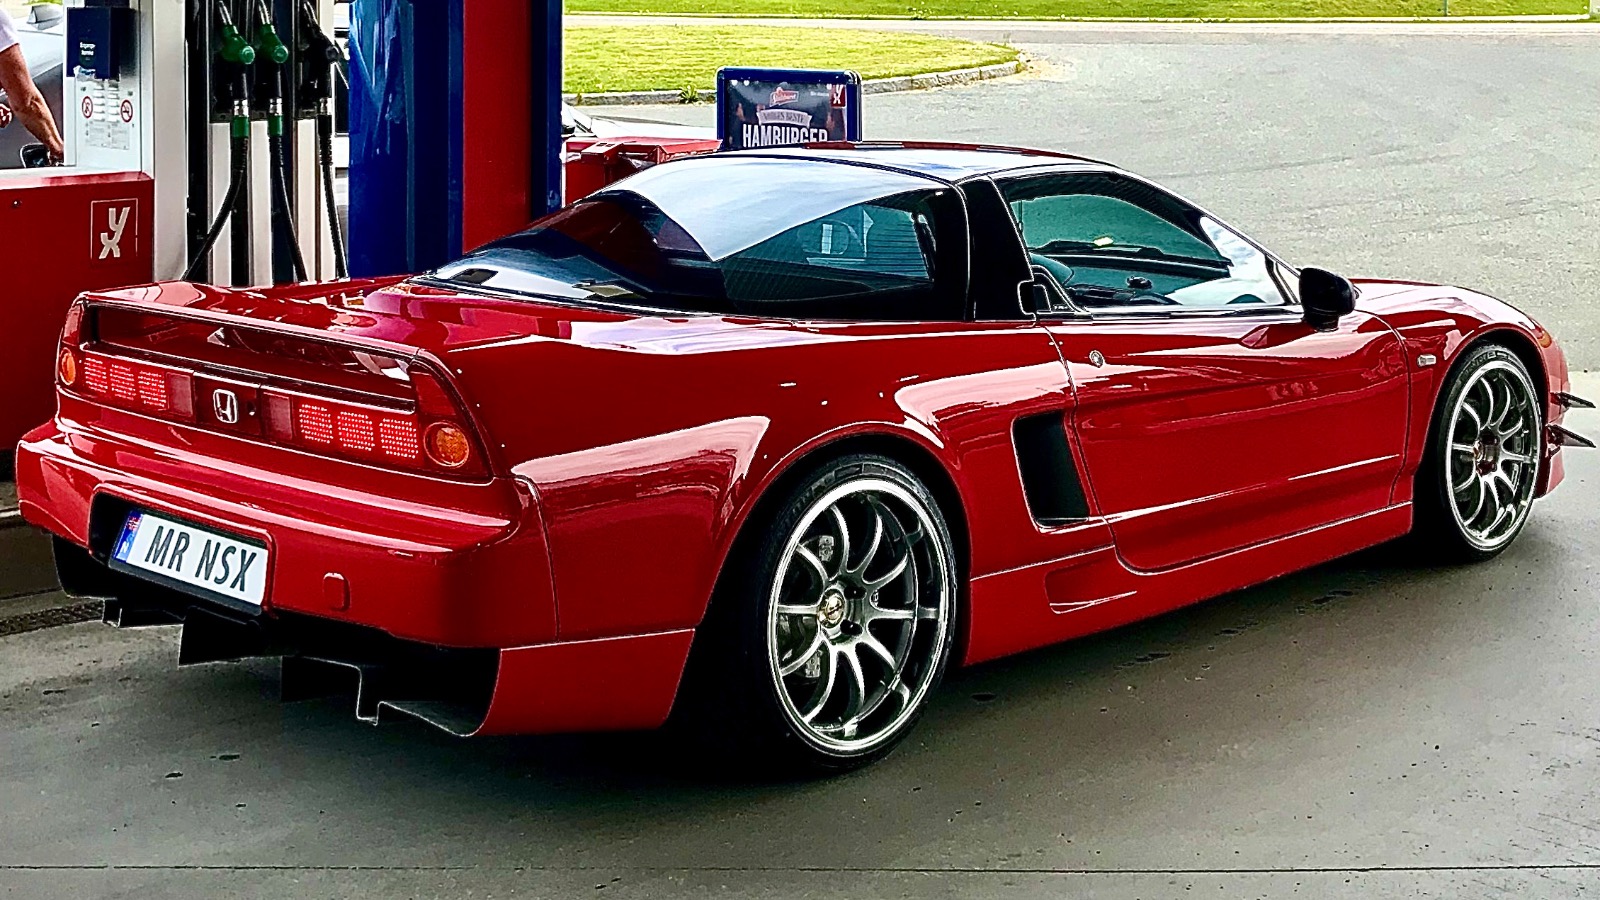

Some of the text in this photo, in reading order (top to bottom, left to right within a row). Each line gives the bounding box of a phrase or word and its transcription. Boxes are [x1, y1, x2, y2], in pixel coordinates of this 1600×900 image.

[742, 124, 828, 147] HAMBURGER
[145, 526, 257, 592] MR NSX
